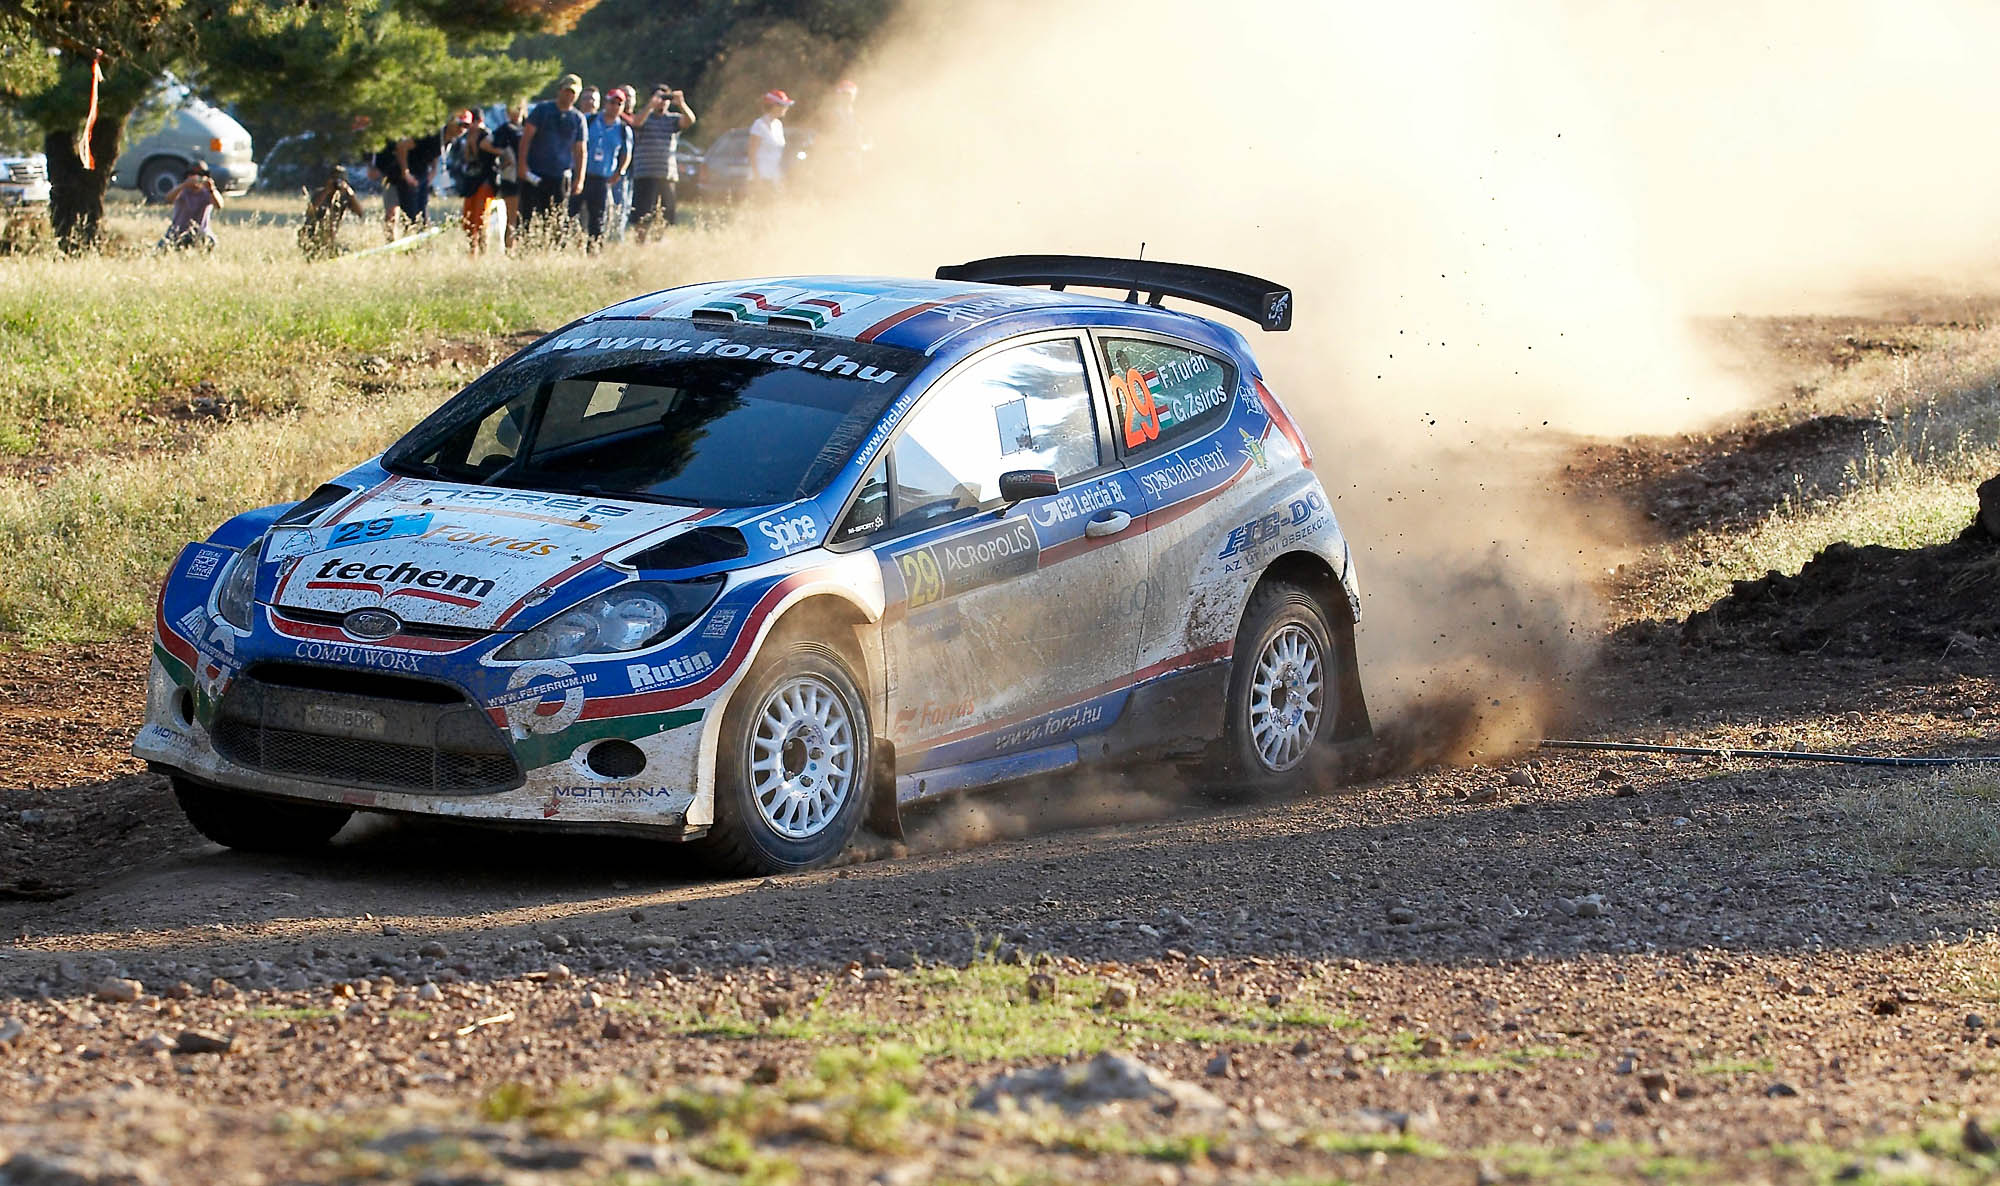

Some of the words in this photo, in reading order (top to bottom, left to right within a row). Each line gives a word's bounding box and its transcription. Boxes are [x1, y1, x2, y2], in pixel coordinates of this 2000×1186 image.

[553, 334, 899, 384] www.ford.hu
[1110, 368, 1159, 448] 29
[856, 395, 912, 466] www.frici.hu
[1073, 486, 1113, 515] Leticia
[1108, 480, 1126, 503] Bt
[335, 517, 394, 544] 29
[421, 524, 559, 556] Forrás
[760, 515, 816, 555] Spice
[848, 521, 875, 534] M-SPORT
[946, 525, 1031, 572] ACROPOLIS
[1224, 560, 1242, 574] AZ
[316, 558, 496, 597] techem
[903, 550, 941, 607] 29
[296, 642, 422, 672] COMPUWORX
[627, 651, 712, 688] Rutin
[554, 785, 671, 797] MONTANA
